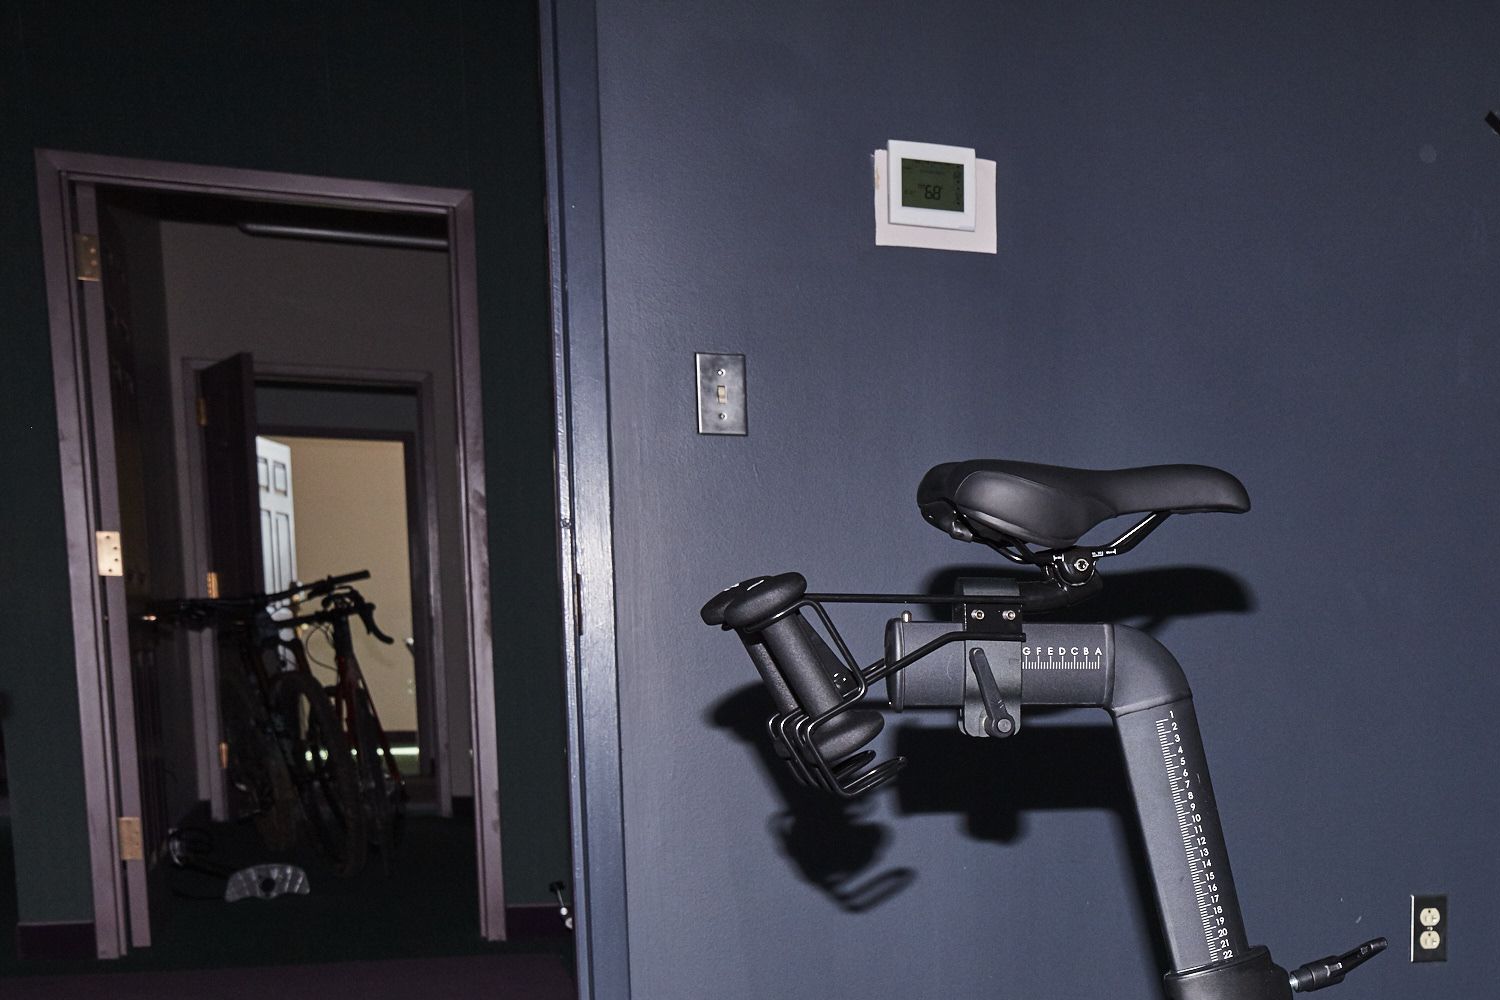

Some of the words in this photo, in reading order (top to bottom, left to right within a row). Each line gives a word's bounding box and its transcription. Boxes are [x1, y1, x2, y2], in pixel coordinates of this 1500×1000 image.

[925, 185, 941, 200] 68
[1022, 647, 1030, 655] G
[1037, 647, 1041, 655] F
[1048, 647, 1053, 655] E
[1059, 647, 1066, 655] D
[1071, 647, 1078, 655] C
[1084, 647, 1089, 655] B
[1095, 647, 1102, 655] A
[1172, 722, 1178, 730] 2
[1174, 734, 1180, 742] 3
[1181, 757, 1185, 765] 5
[1183, 769, 1188, 777] 6
[1185, 780, 1190, 788] 7
[1190, 803, 1195, 811] 9
[1192, 814, 1201, 823] 10
[1194, 825, 1202, 833] 11
[1197, 837, 1206, 845] 12
[1200, 848, 1209, 857] 13
[1202, 859, 1211, 868] 14
[1205, 872, 1214, 881] 15
[1208, 884, 1217, 892] 16
[1211, 894, 1219, 903] 17
[1213, 906, 1222, 914] 18
[1216, 917, 1224, 926] 19
[1217, 928, 1227, 938] 20
[1220, 939, 1229, 948] 21
[1223, 950, 1233, 959] 22
